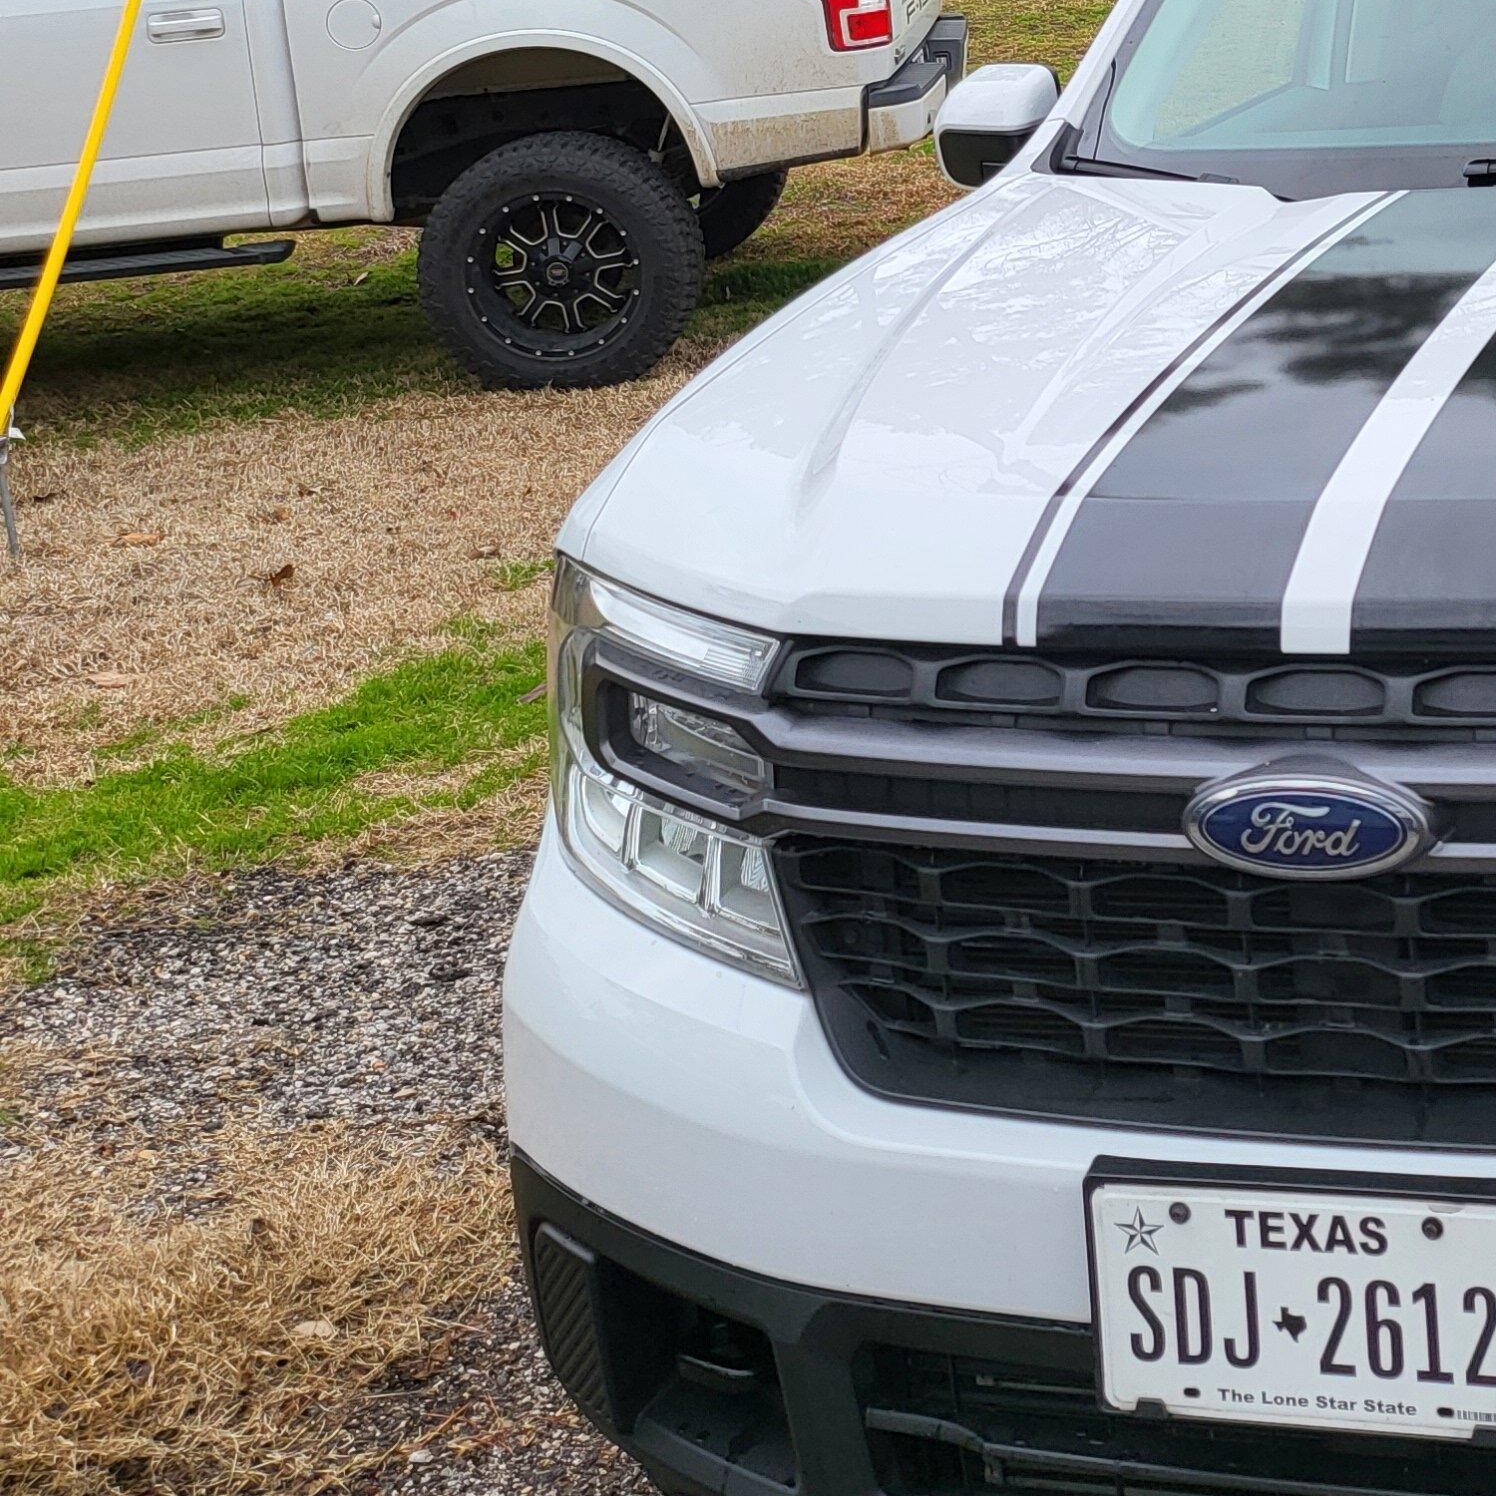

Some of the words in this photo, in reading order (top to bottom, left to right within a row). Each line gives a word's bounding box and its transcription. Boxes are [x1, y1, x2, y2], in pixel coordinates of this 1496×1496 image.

[1240, 801, 1362, 857] Ford
[1224, 1208, 1389, 1257] TEXAS
[1217, 1388, 1255, 1405] The
[1261, 1390, 1309, 1408] Lone
[1316, 1395, 1357, 1412] Star
[1363, 1399, 1418, 1416] State
